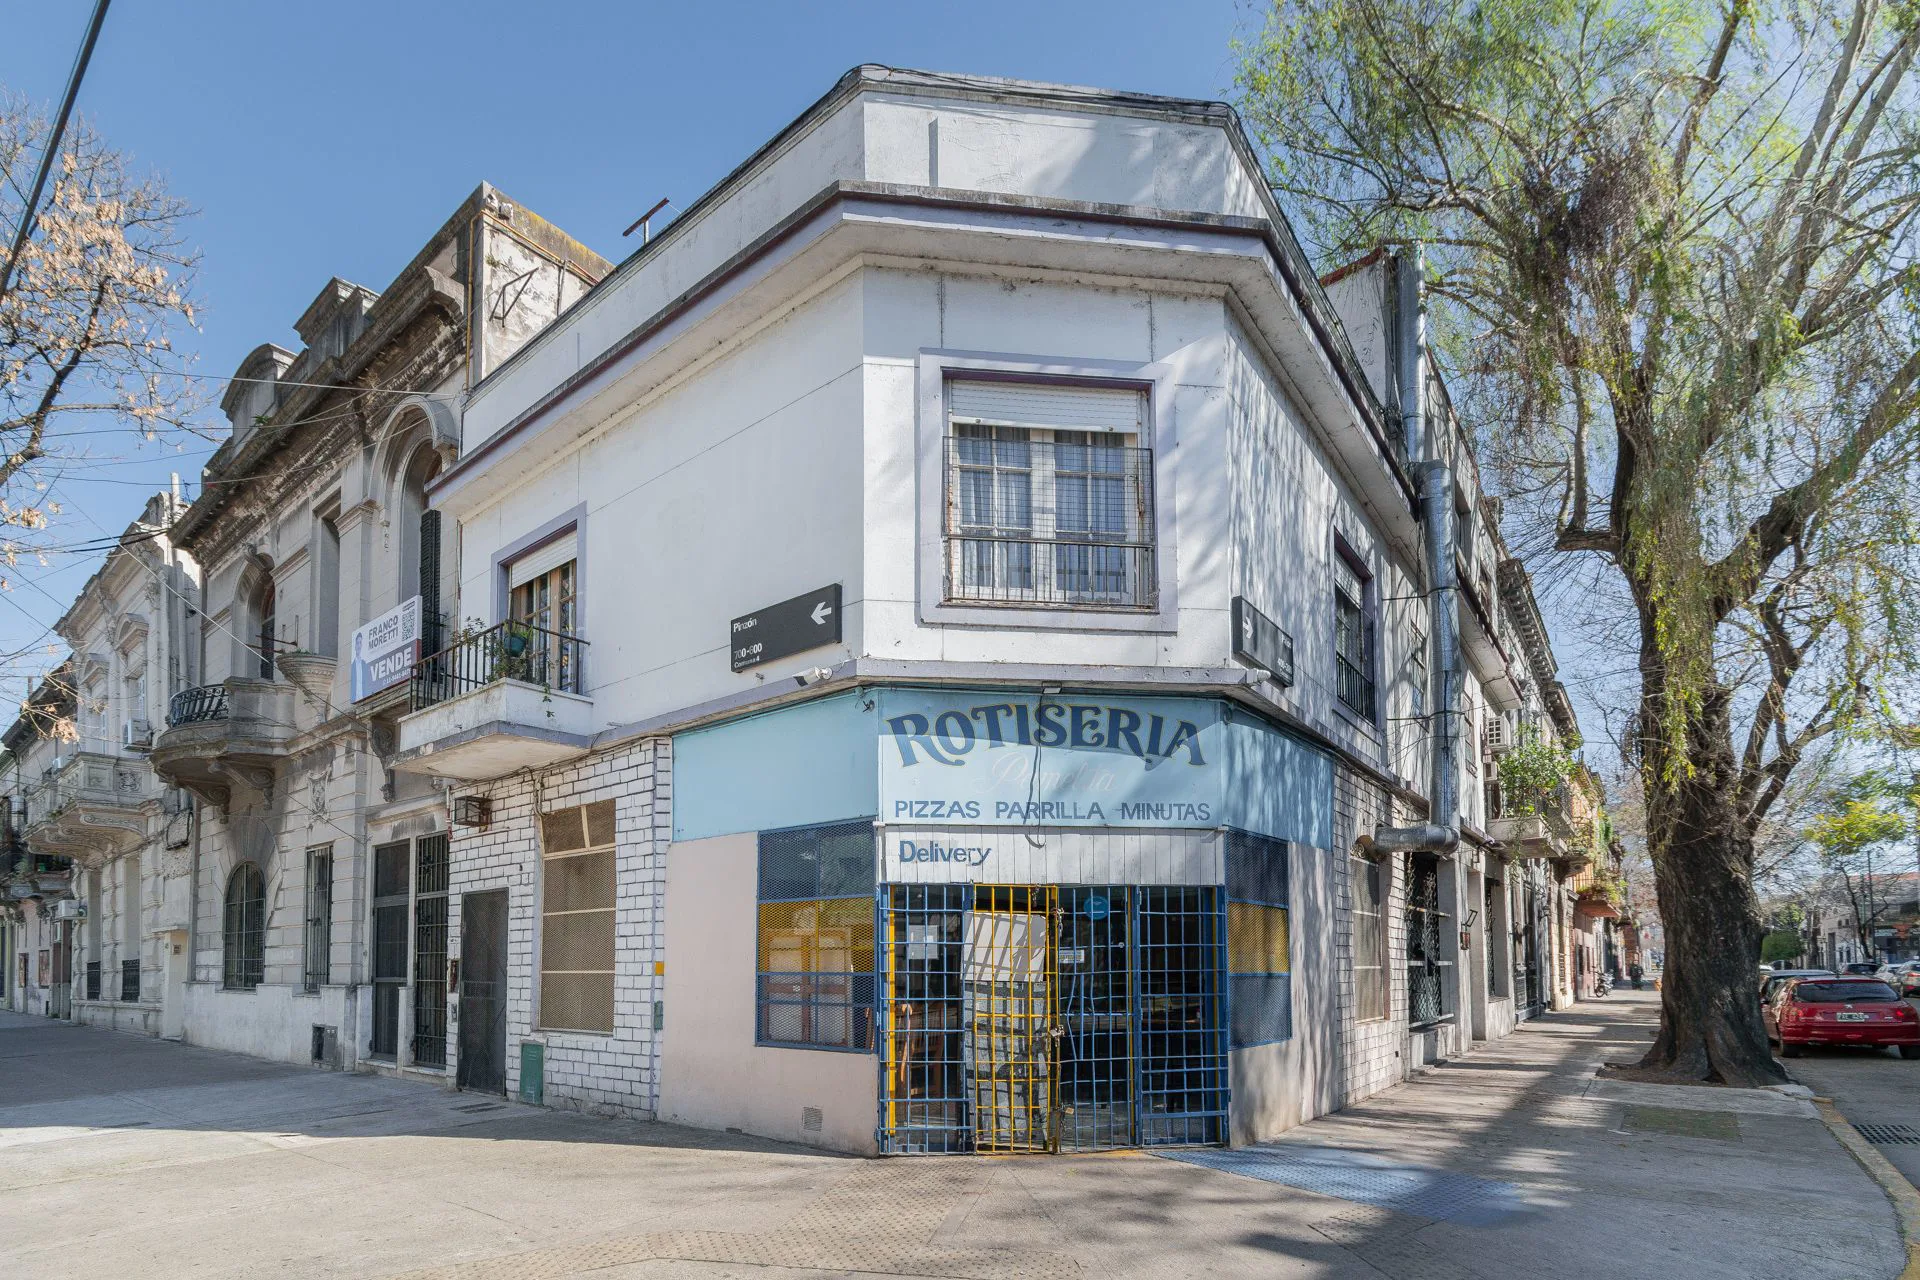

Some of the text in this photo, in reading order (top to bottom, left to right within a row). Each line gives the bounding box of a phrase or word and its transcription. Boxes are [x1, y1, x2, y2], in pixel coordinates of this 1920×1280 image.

[368, 615, 398, 640] FRANCO
[733, 617, 757, 632] Pinzón
[368, 626, 398, 650] MORETTI
[370, 647, 411, 681] VENDE
[734, 643, 762, 660] 700-600
[886, 702, 1207, 771] ROTISERIA
[970, 751, 1117, 793] Pamelta
[895, 800, 1211, 821] PIZZAS PARRILLA MINUTAS
[899, 840, 992, 867] Delivery
